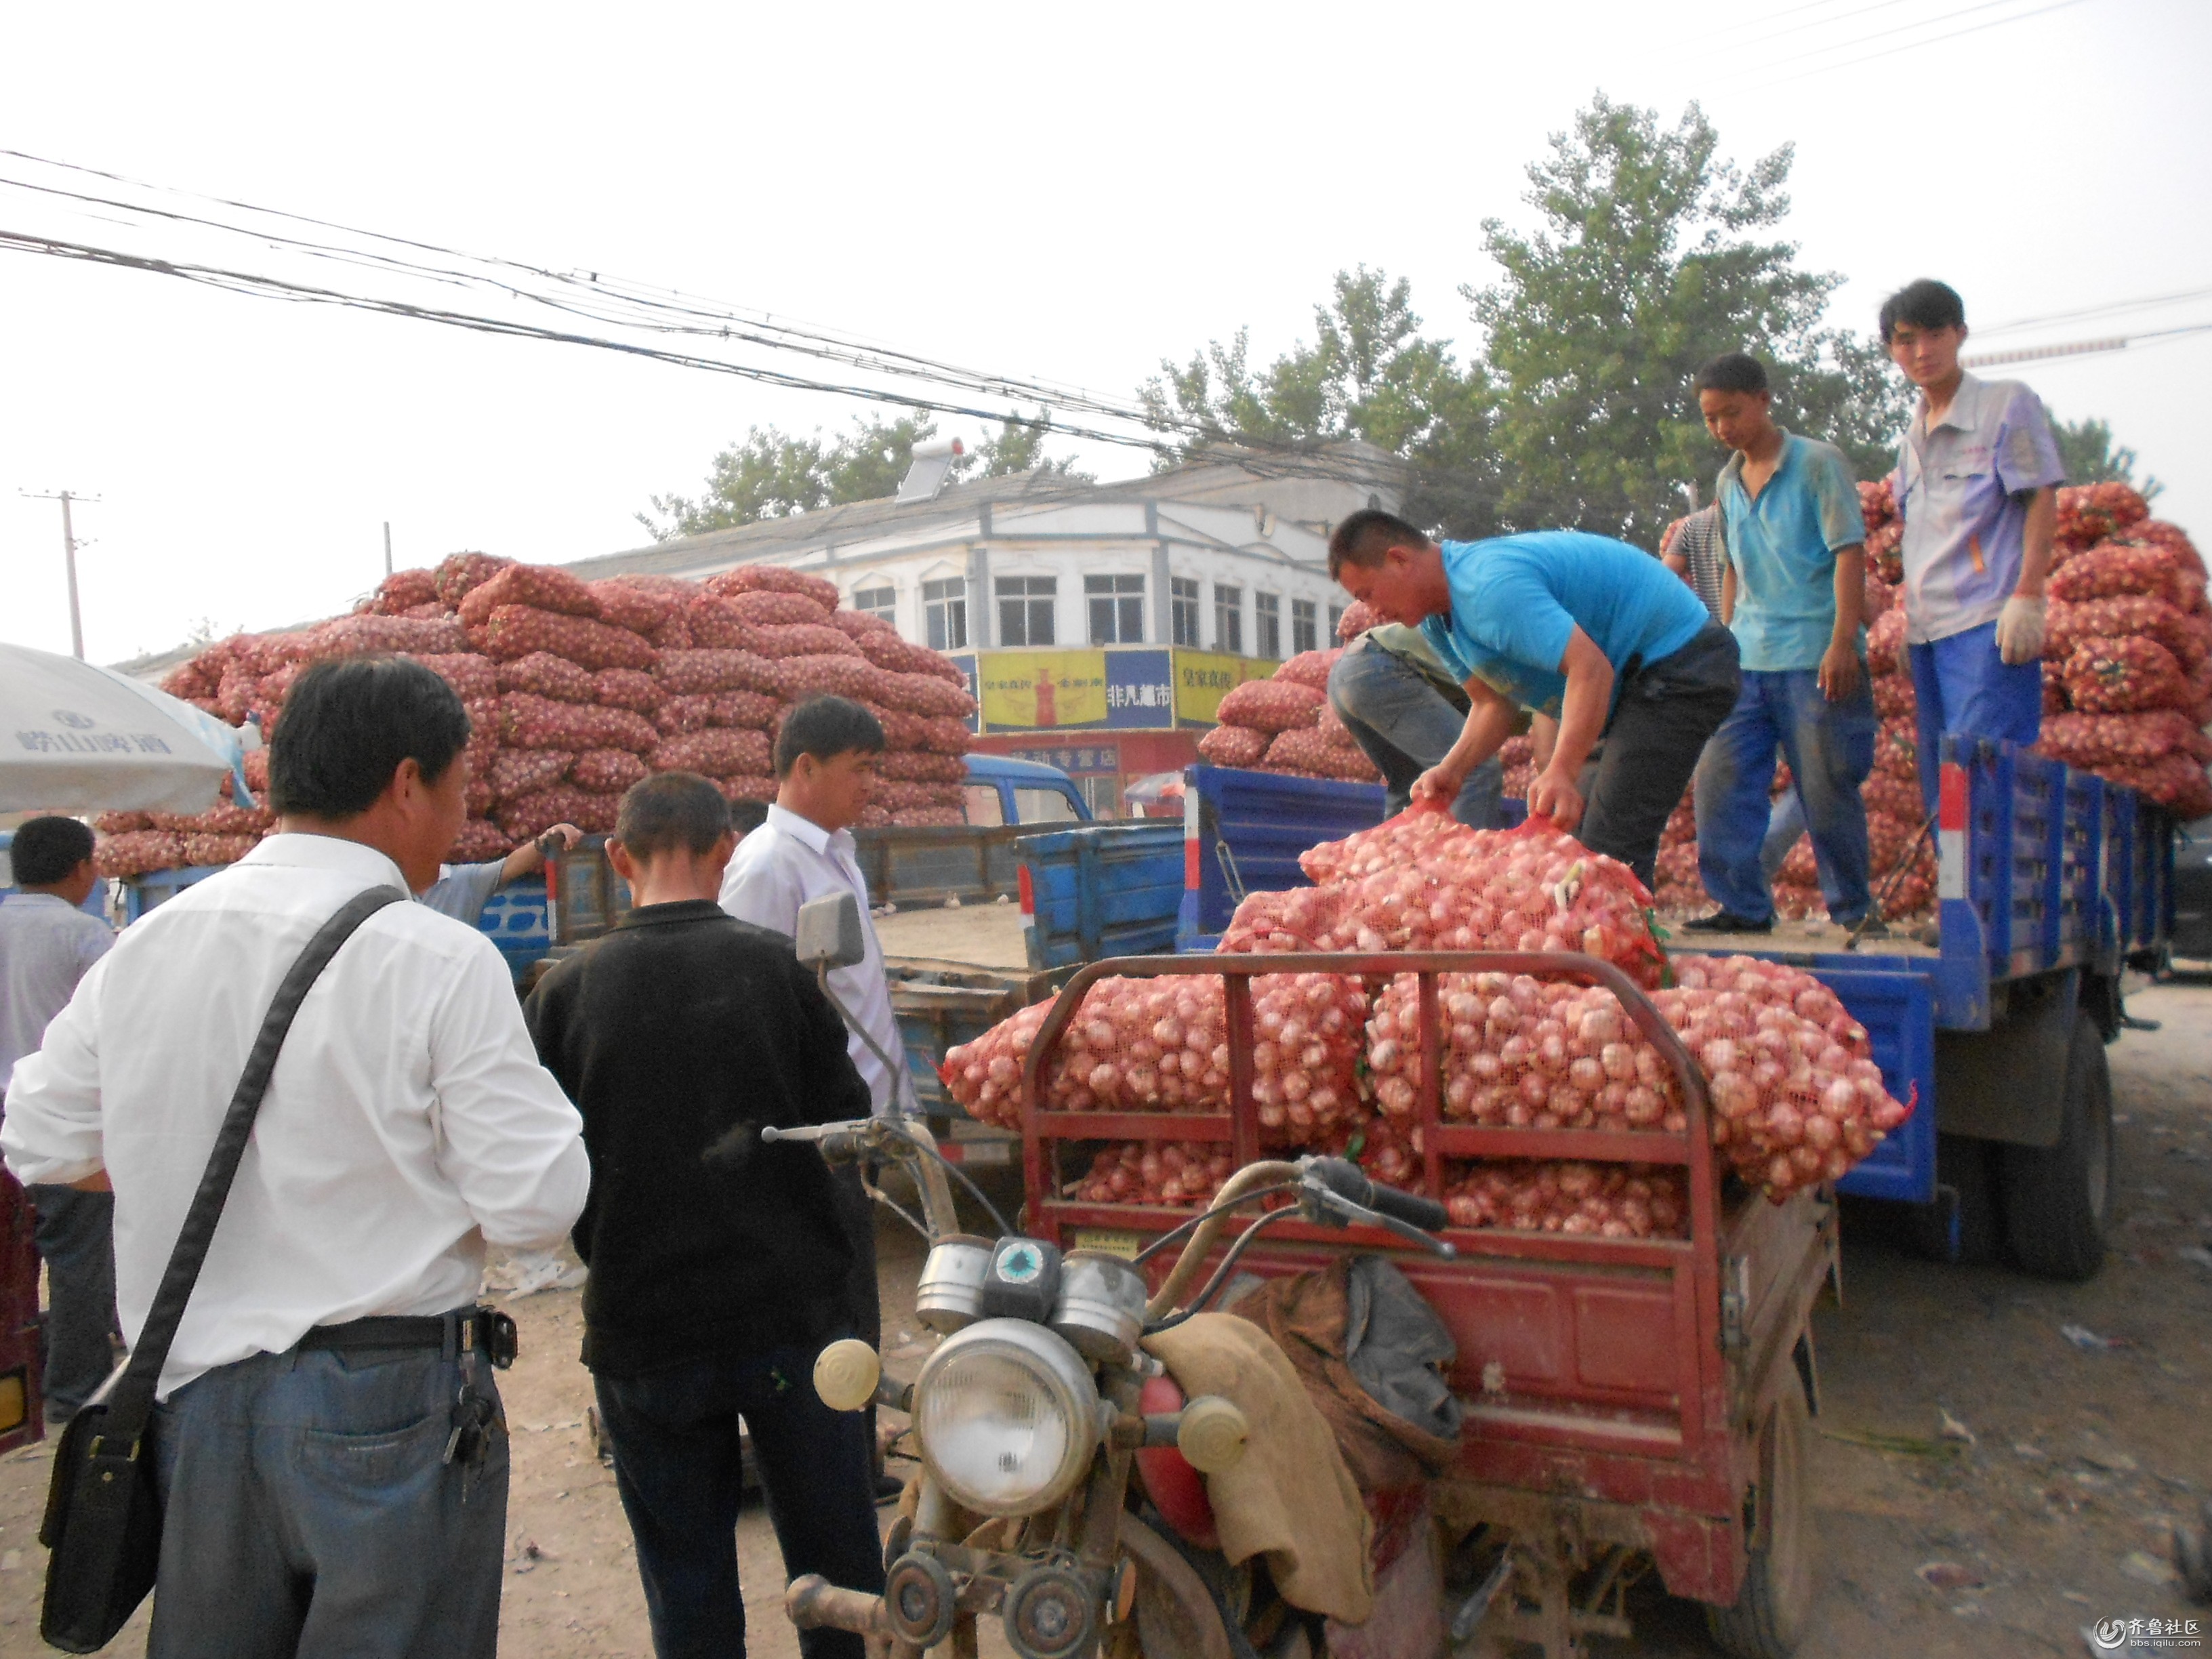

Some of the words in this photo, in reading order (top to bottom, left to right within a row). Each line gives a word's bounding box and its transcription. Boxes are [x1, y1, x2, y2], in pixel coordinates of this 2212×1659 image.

[1107, 683, 1170, 708] 非凡超市
[16, 731, 172, 754] 崂山啤酒
